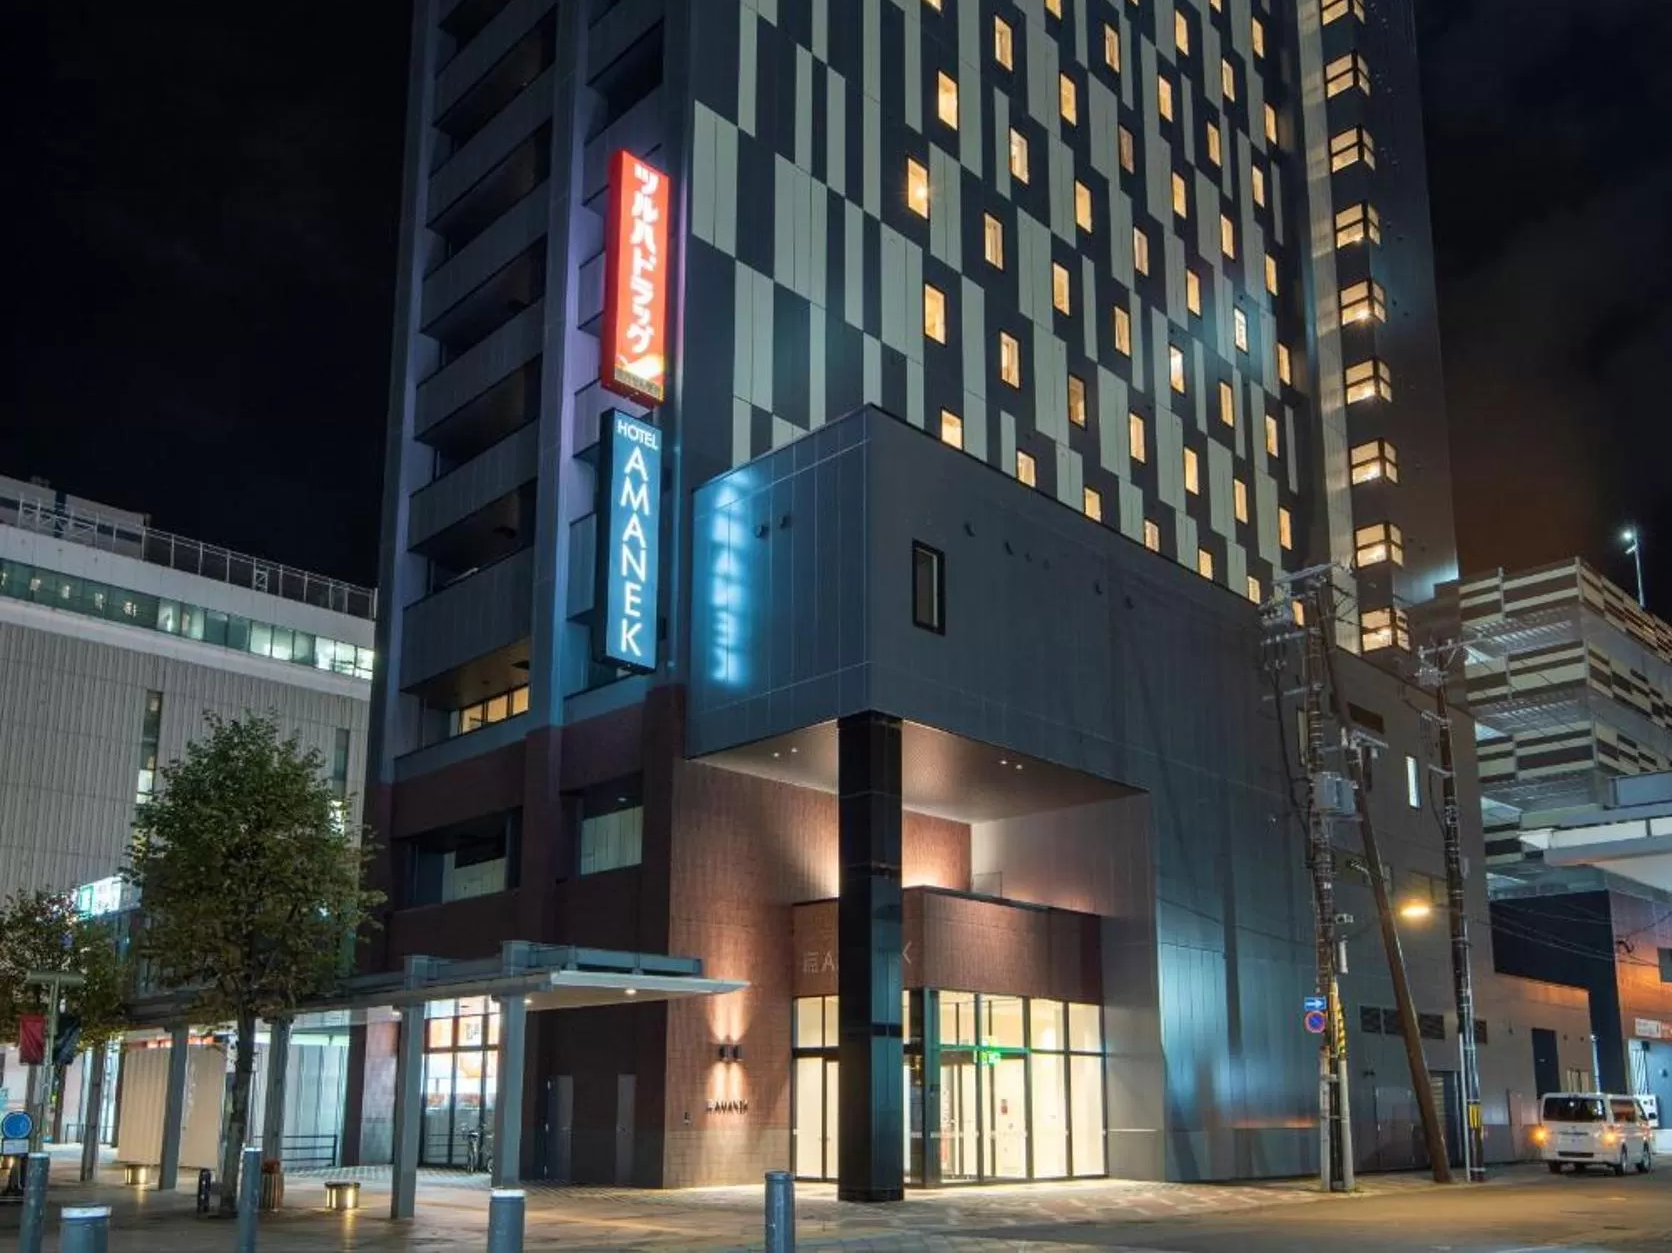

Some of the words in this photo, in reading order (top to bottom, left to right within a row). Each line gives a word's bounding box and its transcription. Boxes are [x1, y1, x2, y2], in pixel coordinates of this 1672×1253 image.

[627, 163, 659, 353] ツルハドラッグ
[617, 419, 659, 451] HOTEL
[620, 445, 650, 656] AMANEK
